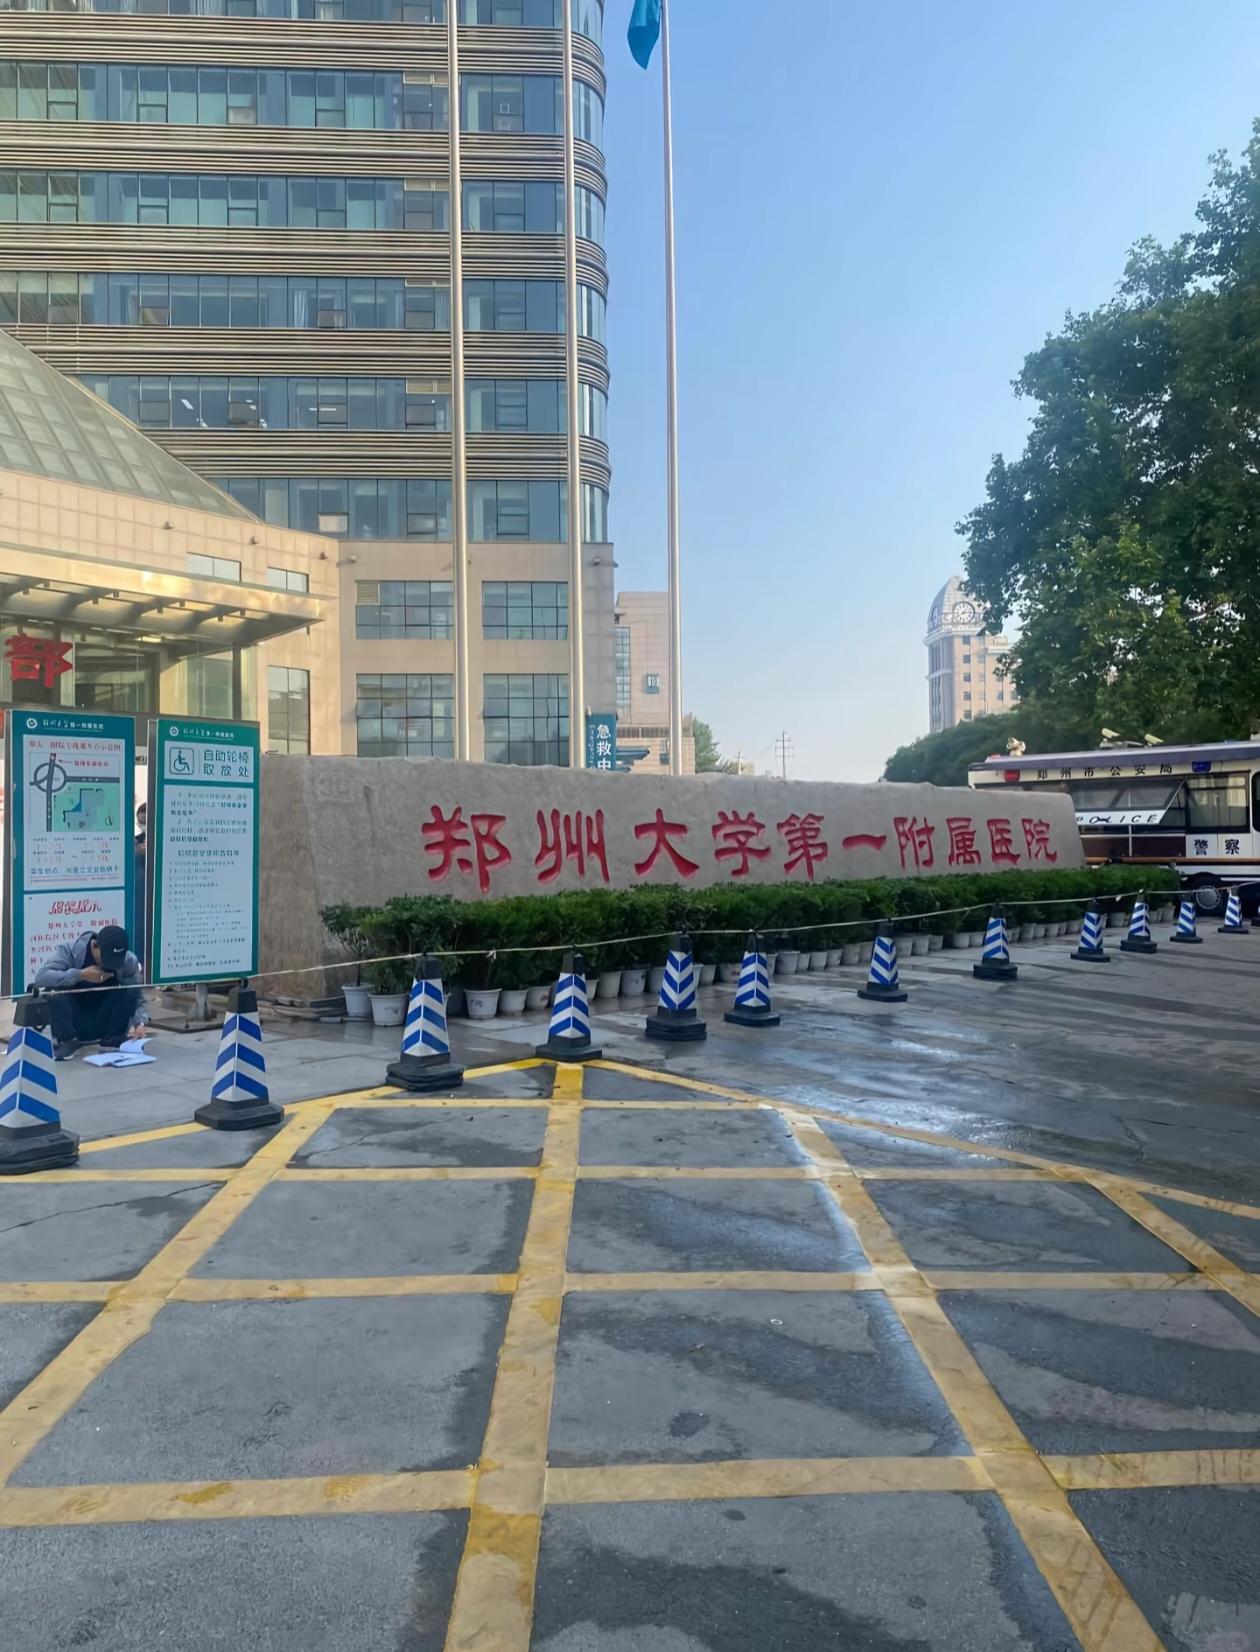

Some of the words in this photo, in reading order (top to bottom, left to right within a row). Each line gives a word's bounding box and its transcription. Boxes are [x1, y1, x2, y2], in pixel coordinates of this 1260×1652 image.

[4, 632, 74, 688] 部
[596, 723, 612, 770] 急救中
[203, 749, 249, 764] 自助轮椅
[203, 763, 249, 778] 取放处
[1037, 763, 1172, 780] 郑州市公安局
[421, 804, 1058, 894] 郑州大学第一附属医院
[1193, 838, 1240, 856] 警察
